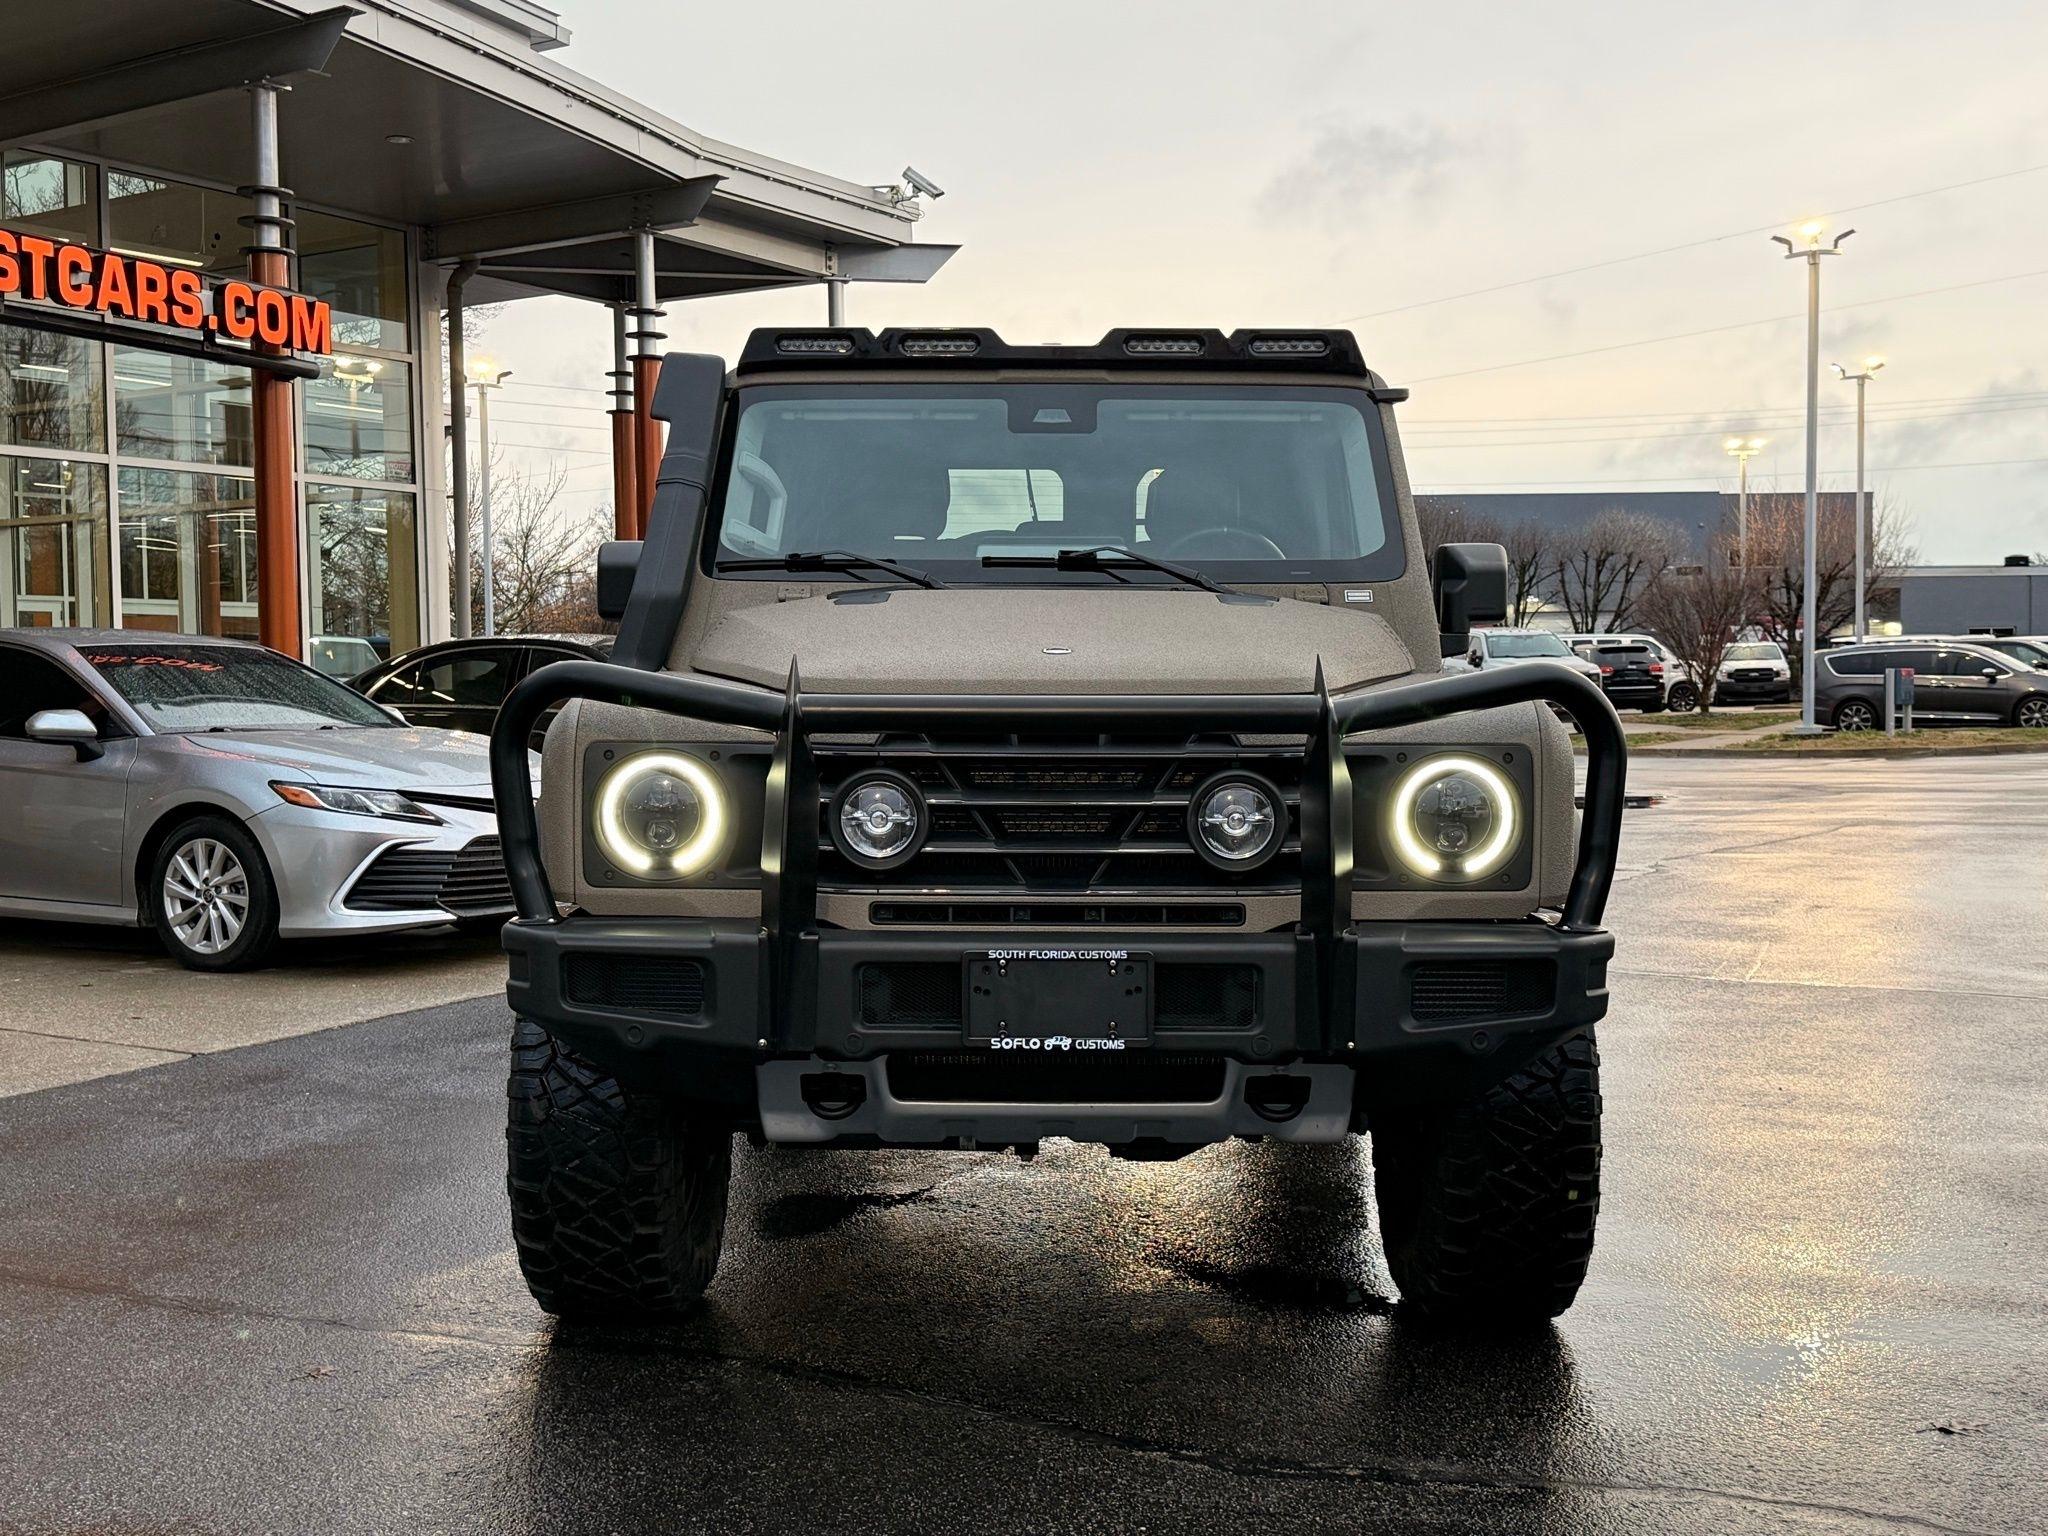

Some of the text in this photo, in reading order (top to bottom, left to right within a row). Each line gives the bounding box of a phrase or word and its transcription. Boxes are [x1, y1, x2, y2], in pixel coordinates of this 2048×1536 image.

[988, 950, 1128, 959] SOUTH FLORIDA CUSTOMS
[990, 1038, 1126, 1050] SOFLO CUSTOMS
